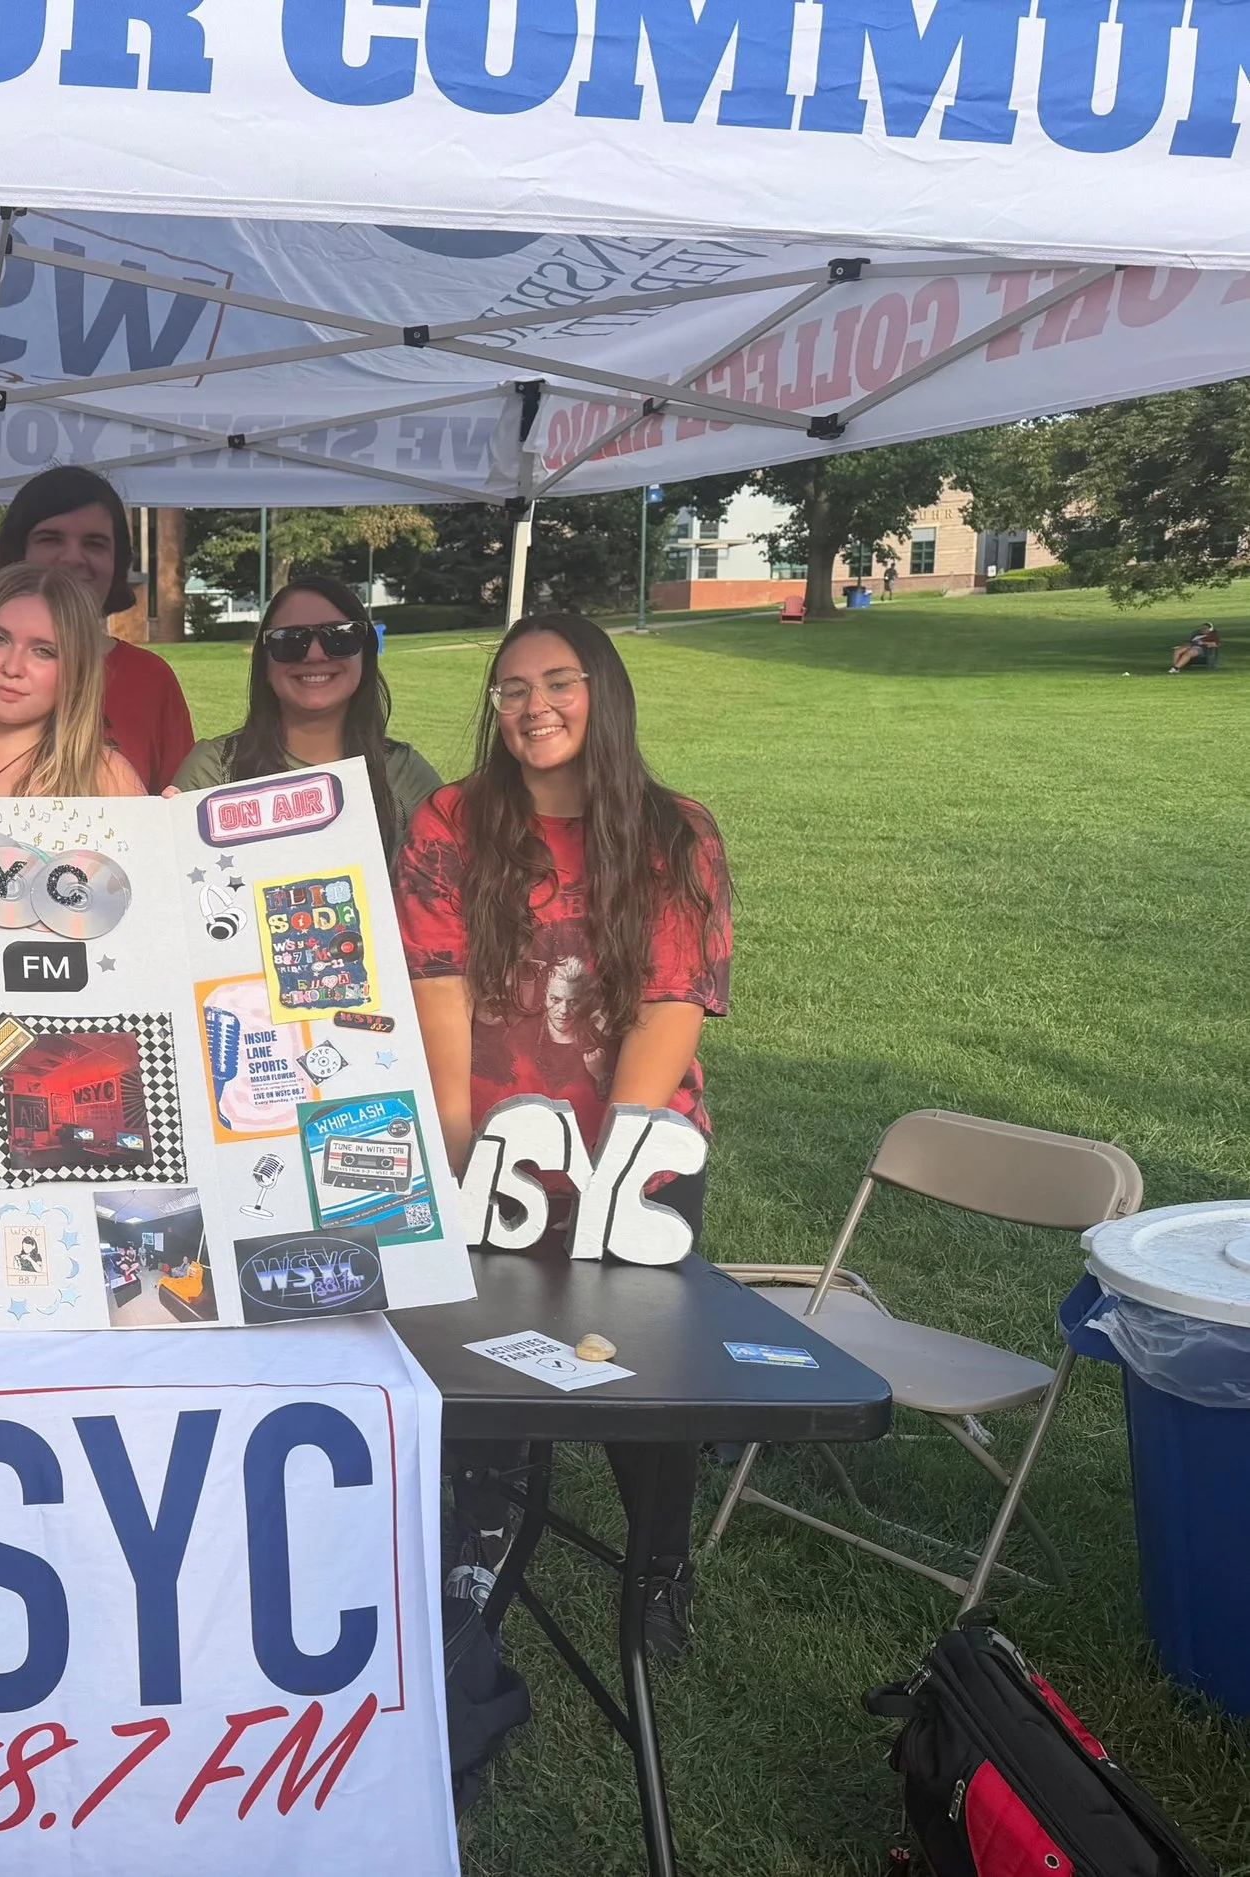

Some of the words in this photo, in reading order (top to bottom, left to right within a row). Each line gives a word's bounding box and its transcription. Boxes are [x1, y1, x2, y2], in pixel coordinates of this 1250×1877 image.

[218, 799, 261, 830] ON
[272, 788, 324, 823] AIR
[23, 955, 70, 979] FM
[244, 1030, 277, 1045] INSIDE
[246, 1046, 272, 1059] LANE
[309, 1048, 329, 1063] WSYC
[248, 1059, 288, 1074] SPORTS
[250, 1075, 270, 1083] MASON
[271, 1072, 296, 1081] FLOWERS
[73, 1081, 114, 1104] WSYC
[254, 1092, 265, 1100] LIVE
[275, 1090, 291, 1098] WSYC
[314, 1102, 387, 1134] WHIPLASH
[333, 1142, 352, 1152] TUNE
[355, 1144, 363, 1152] IN
[366, 1145, 384, 1154] WITH
[11, 1226, 40, 1236] WSYC
[252, 1248, 365, 1291] WSYC
[484, 1338, 547, 1356] ACTIVITIES
[499, 1351, 530, 1363] FAIR
[529, 1344, 562, 1358] PASS
[176, 1693, 378, 1825] FM
